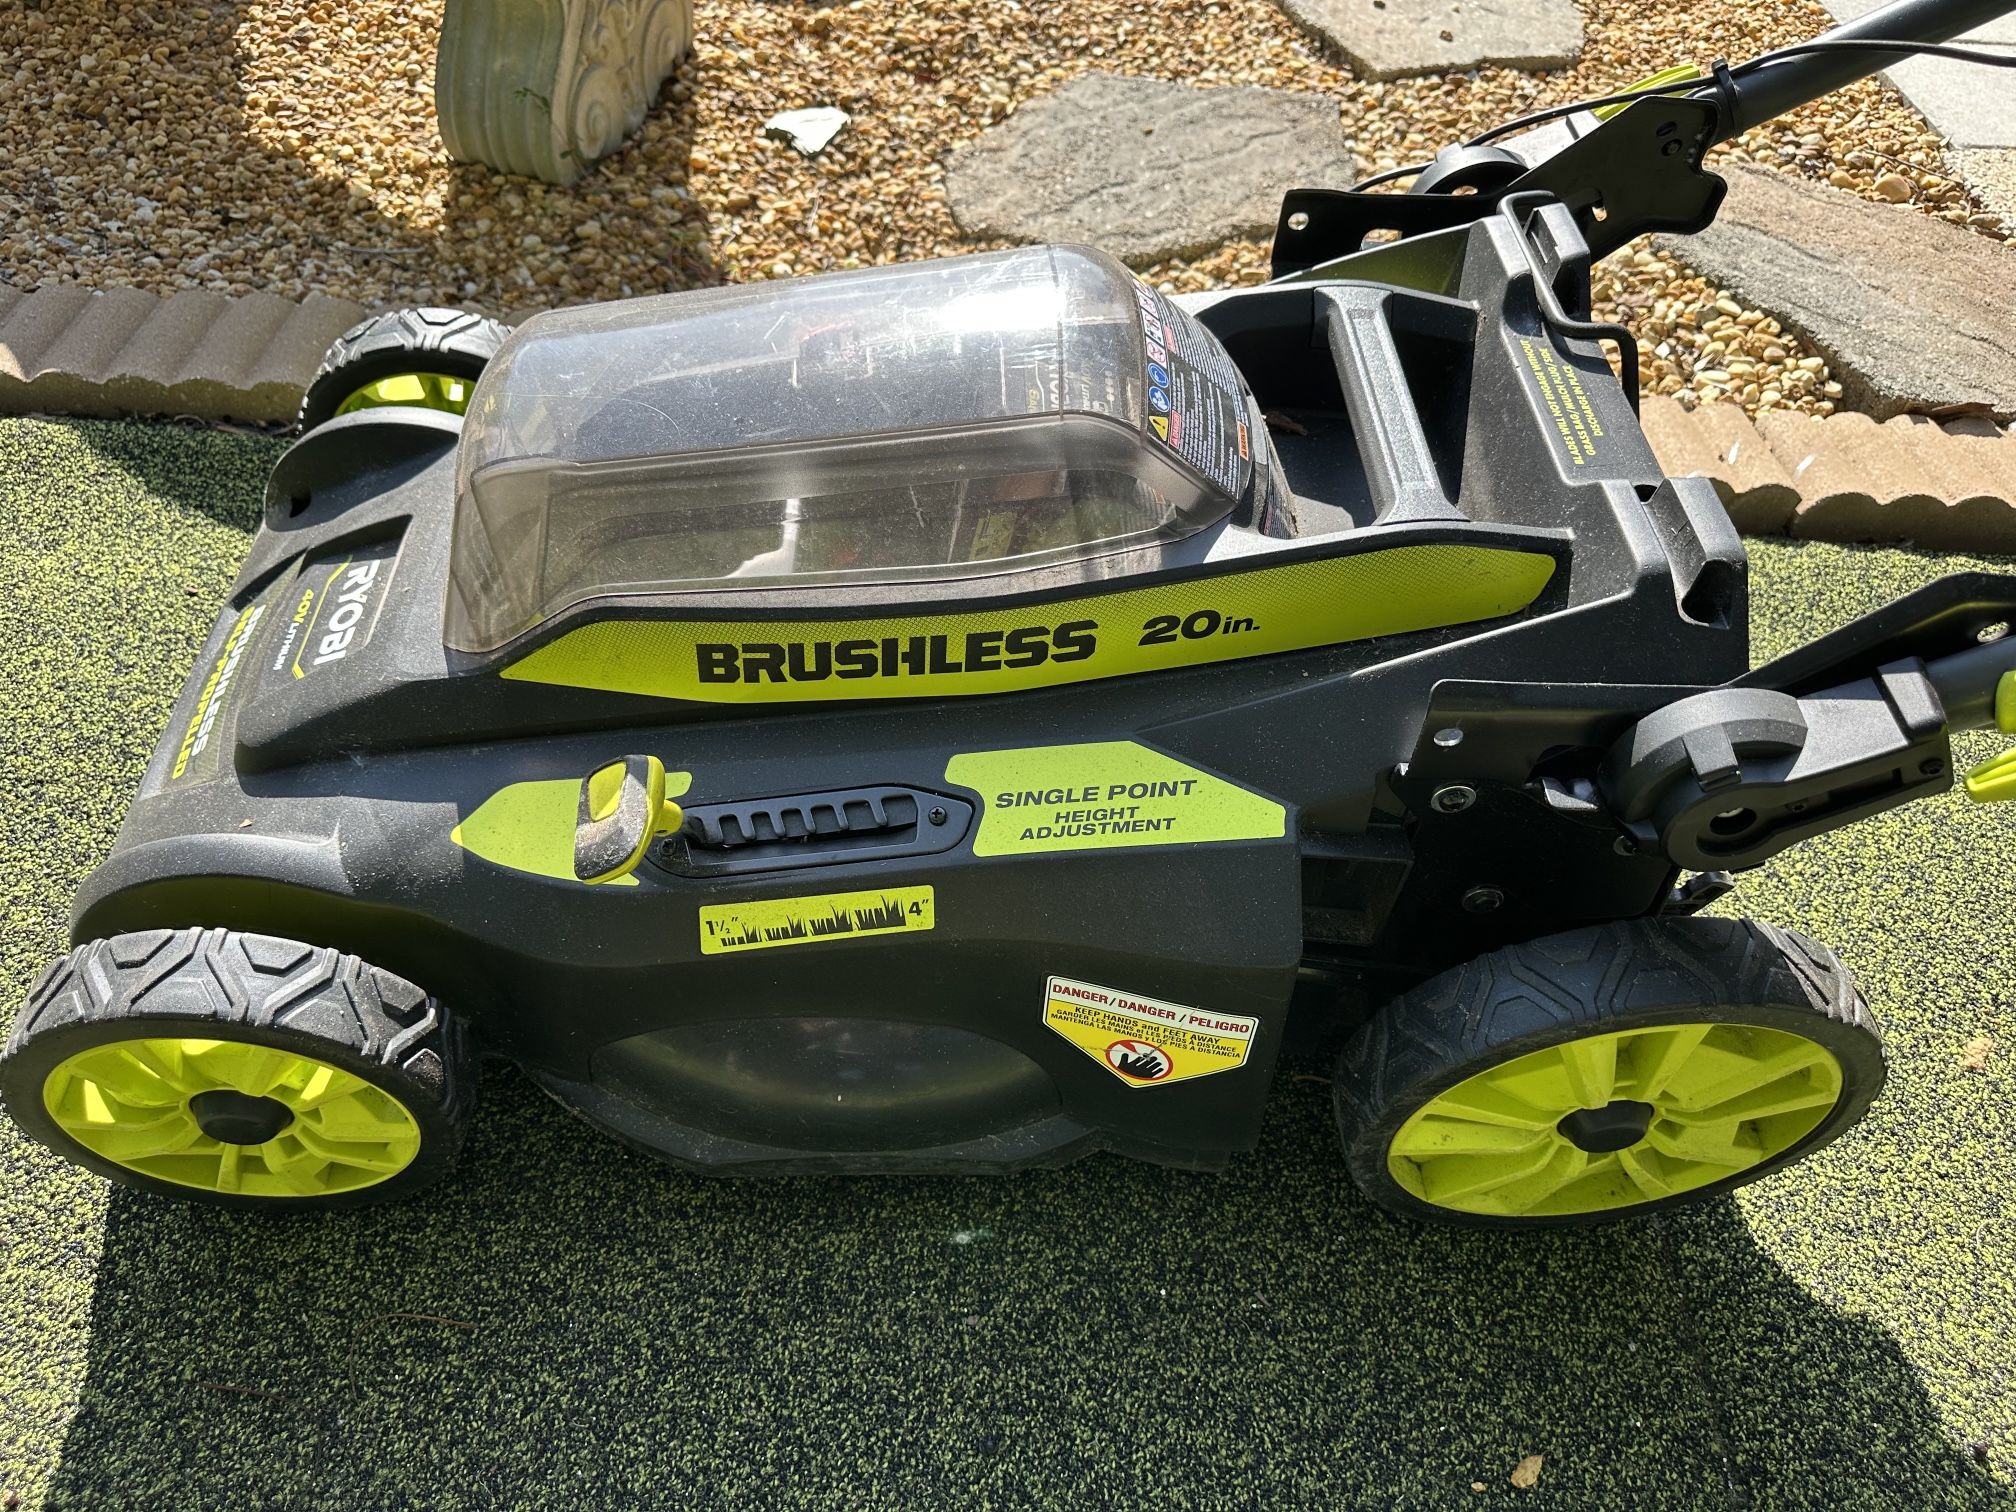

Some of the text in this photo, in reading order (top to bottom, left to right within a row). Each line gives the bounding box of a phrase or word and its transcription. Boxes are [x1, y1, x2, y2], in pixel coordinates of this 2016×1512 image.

[1520, 340, 1584, 465] BLADES WILL NOT ENGAGE WITHOUT
[1572, 384, 1584, 397] IN
[1578, 395, 1604, 436] DISCHARGE
[1577, 430, 1596, 456] GRASS
[273, 589, 314, 671] 40V LITHIUM
[313, 560, 381, 665] RYOBI
[695, 619, 1099, 684] BRUSHLESS
[172, 606, 255, 780] SELF-PROPELLED
[191, 604, 266, 757] BRUSHLESS
[995, 779, 1198, 809] SINGLE POINT
[1054, 806, 1140, 824] HEIGHT
[1019, 817, 1177, 841] ADJUSTMENT
[1053, 984, 1108, 1004] DANGER
[1118, 999, 1176, 1020] DANGER
[1189, 1016, 1249, 1033] PELIGRO
[1056, 1009, 1089, 1020] GARDER
[1091, 1017, 1106, 1026] LES
[1108, 1021, 1134, 1031] MAINS
[1146, 1030, 1160, 1038] LES
[1197, 1041, 1236, 1052] DISTANCE
[1075, 1006, 1221, 1044] KEEP HANDS and FEET AWAY
[1051, 1013, 1095, 1028] MANTENGA
[1097, 1023, 1112, 1031] LAS
[1114, 1027, 1143, 1039] MANOS
[1152, 1037, 1168, 1045] LOS
[1170, 1041, 1187, 1050] PIES
[1197, 1046, 1240, 1058] DISTANCIA
